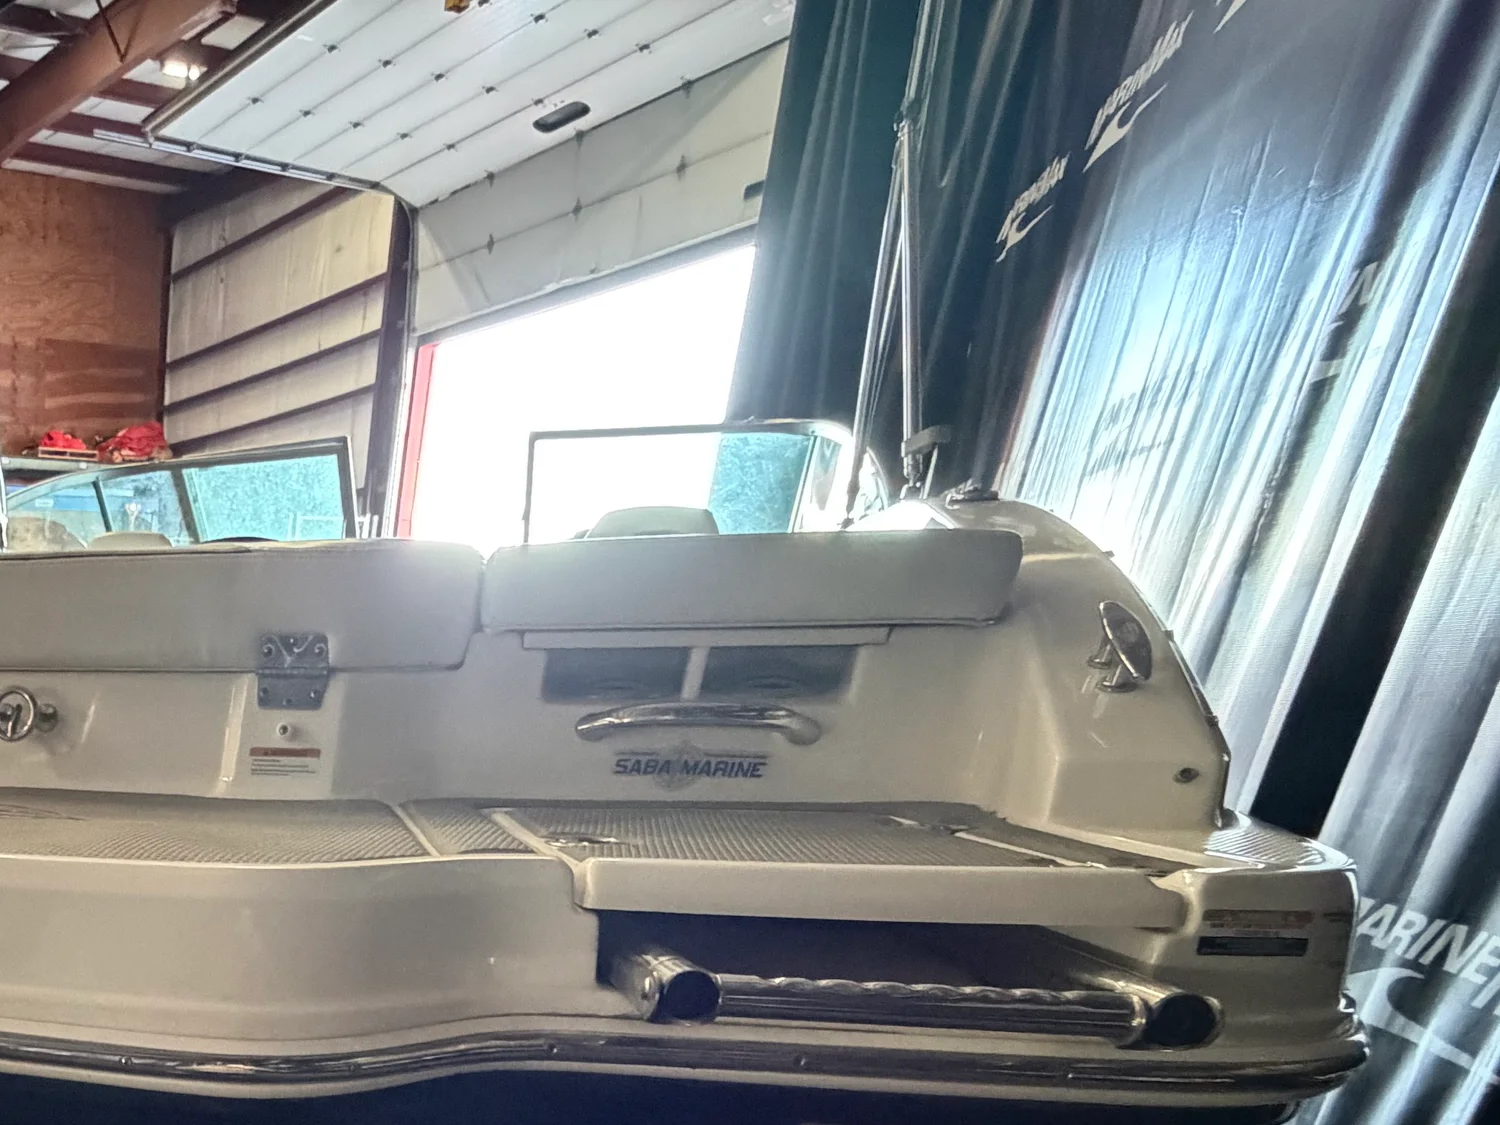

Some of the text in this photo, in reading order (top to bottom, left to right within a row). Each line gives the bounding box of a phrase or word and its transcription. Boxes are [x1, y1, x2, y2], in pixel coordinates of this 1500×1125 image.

[613, 758, 767, 778] SABA MARINE
[1357, 897, 1500, 1016] ARINE
